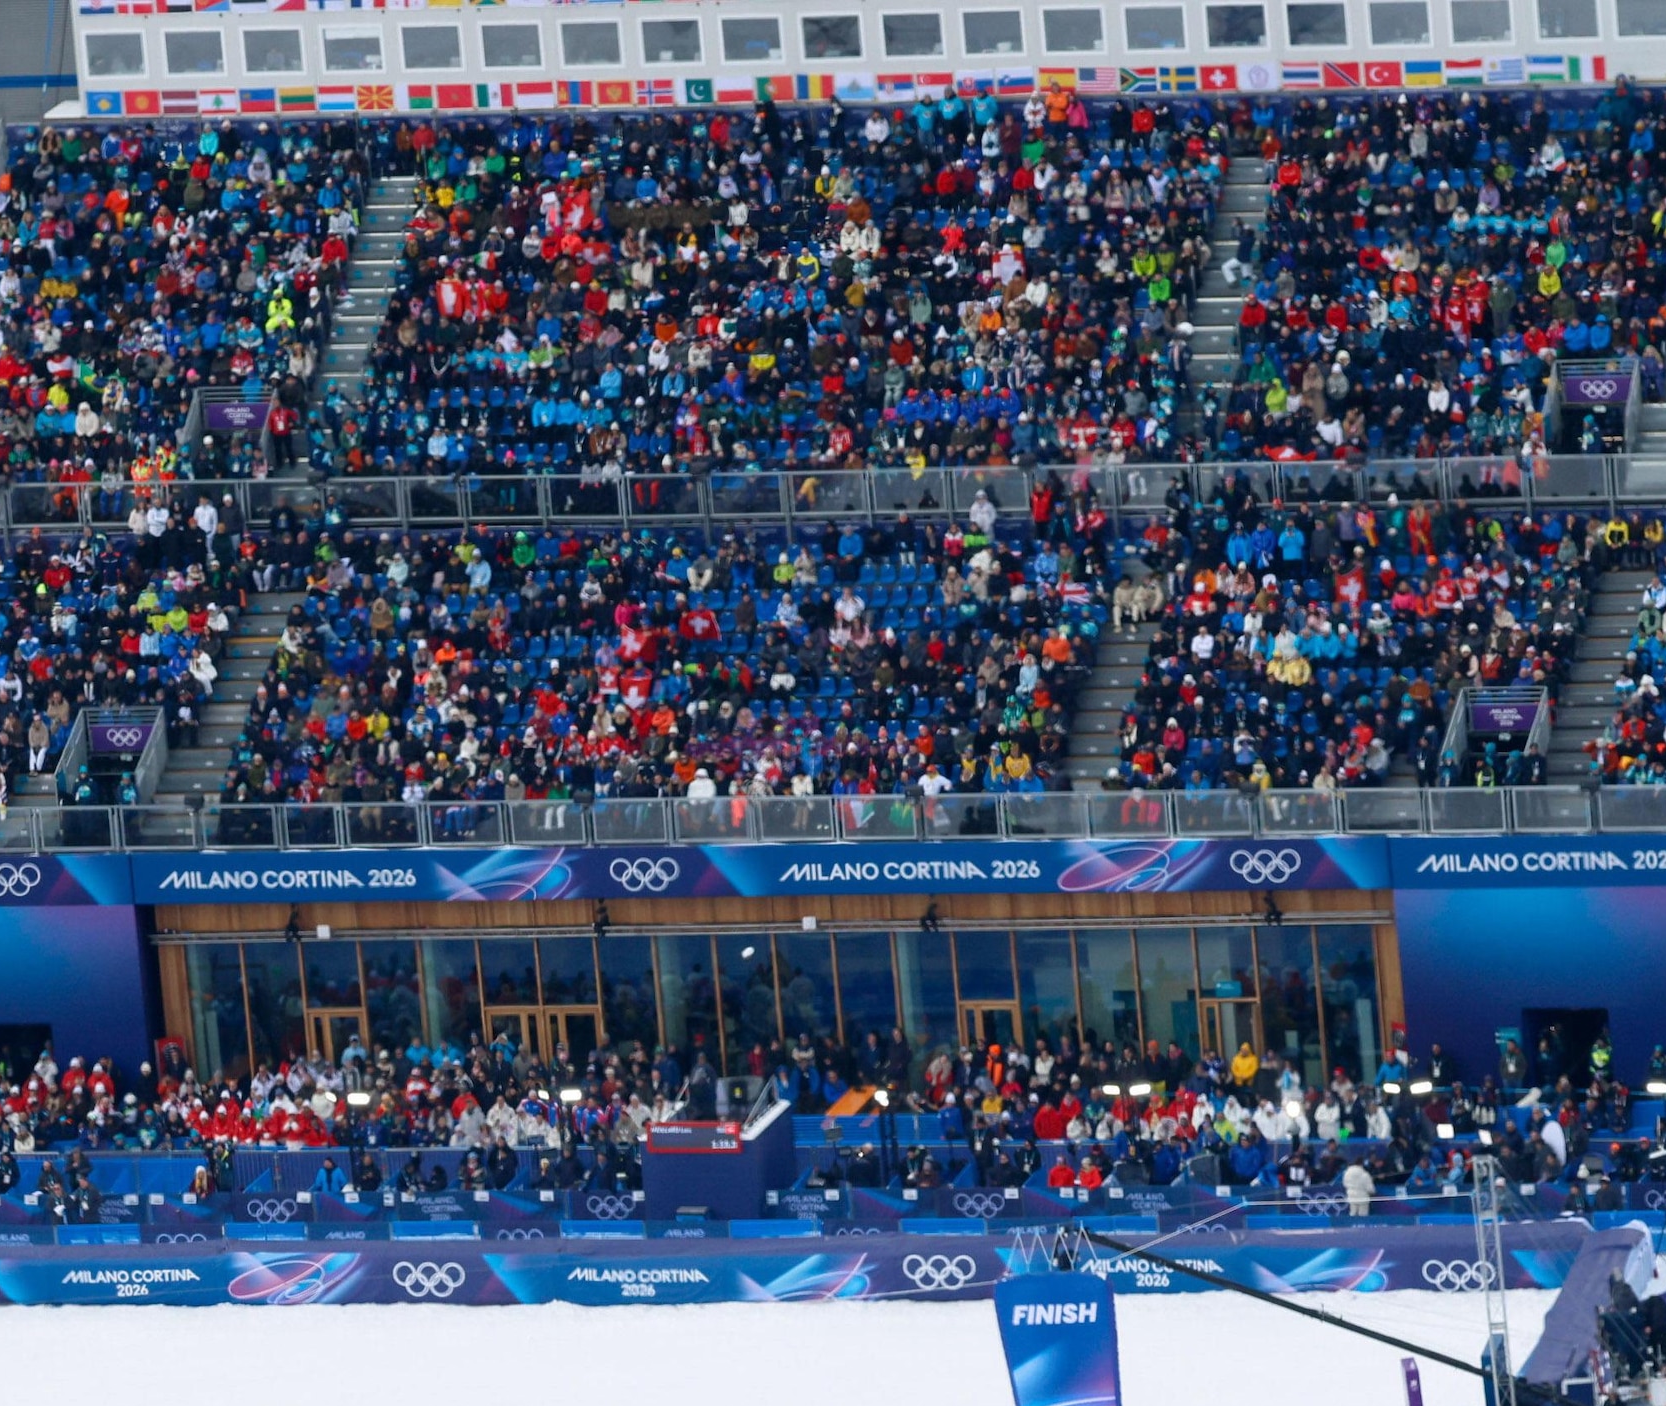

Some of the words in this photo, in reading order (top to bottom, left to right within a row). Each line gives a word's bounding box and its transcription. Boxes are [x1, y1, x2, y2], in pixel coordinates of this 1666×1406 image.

[1416, 853, 1518, 873] MILANO
[1521, 851, 1628, 871] CORTINA
[159, 870, 258, 889] MILANO
[261, 869, 364, 888] CORTINA
[368, 868, 416, 887] 2026
[779, 862, 879, 882] MILANO
[883, 860, 987, 880] CORTINA
[991, 860, 1040, 879] 2026
[325, 1231, 366, 1239] MILANO
[663, 1228, 706, 1237] MILANO
[1079, 1259, 1150, 1273] MILANO
[61, 1269, 130, 1285] MILANO
[131, 1267, 200, 1282] CORTINA
[566, 1267, 635, 1282] MILANO
[636, 1267, 710, 1283] CORTINA
[1136, 1273, 1170, 1287] 2026
[116, 1282, 149, 1297] 2026
[621, 1283, 656, 1297] 2026
[1011, 1302, 1098, 1326] FINISH
